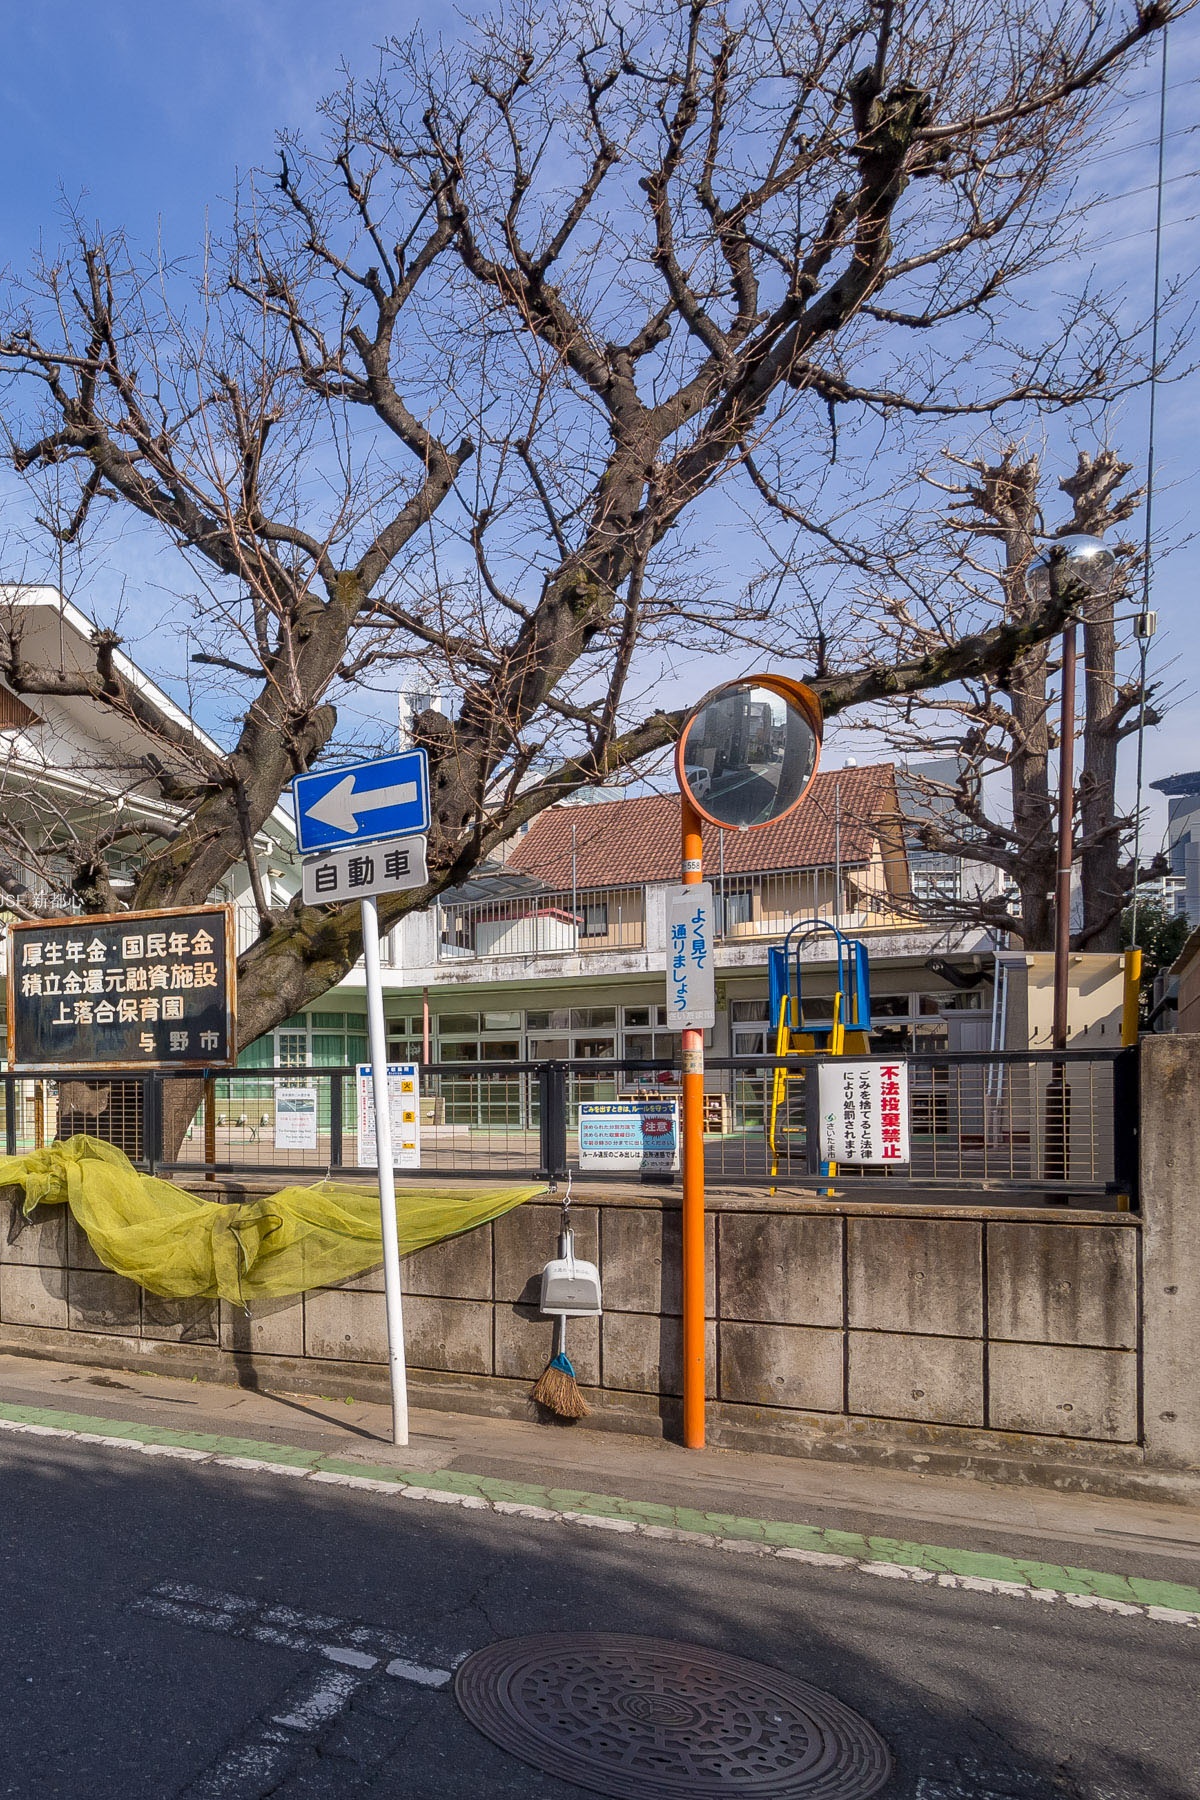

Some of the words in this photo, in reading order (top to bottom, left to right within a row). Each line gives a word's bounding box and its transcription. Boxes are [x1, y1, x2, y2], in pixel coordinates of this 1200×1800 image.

[315, 850, 411, 893] 自動車
[22, 928, 215, 967] 厚生年金・国民年金
[690, 907, 707, 969] よく見て
[21, 962, 218, 997] 積立金還元融資施設
[671, 923, 689, 1011] 通りましょう
[52, 995, 184, 1026] 上落合保育園
[582, 1105, 674, 1114] ごみを出すときは、ルールを守って
[645, 1121, 668, 1132] 注意
[843, 1071, 857, 1159] により処罰されます
[858, 1070, 873, 1159] ごみを捨てると法律
[880, 1065, 901, 1159] 不法投棄禁止
[826, 1122, 836, 1159] さいたま市
